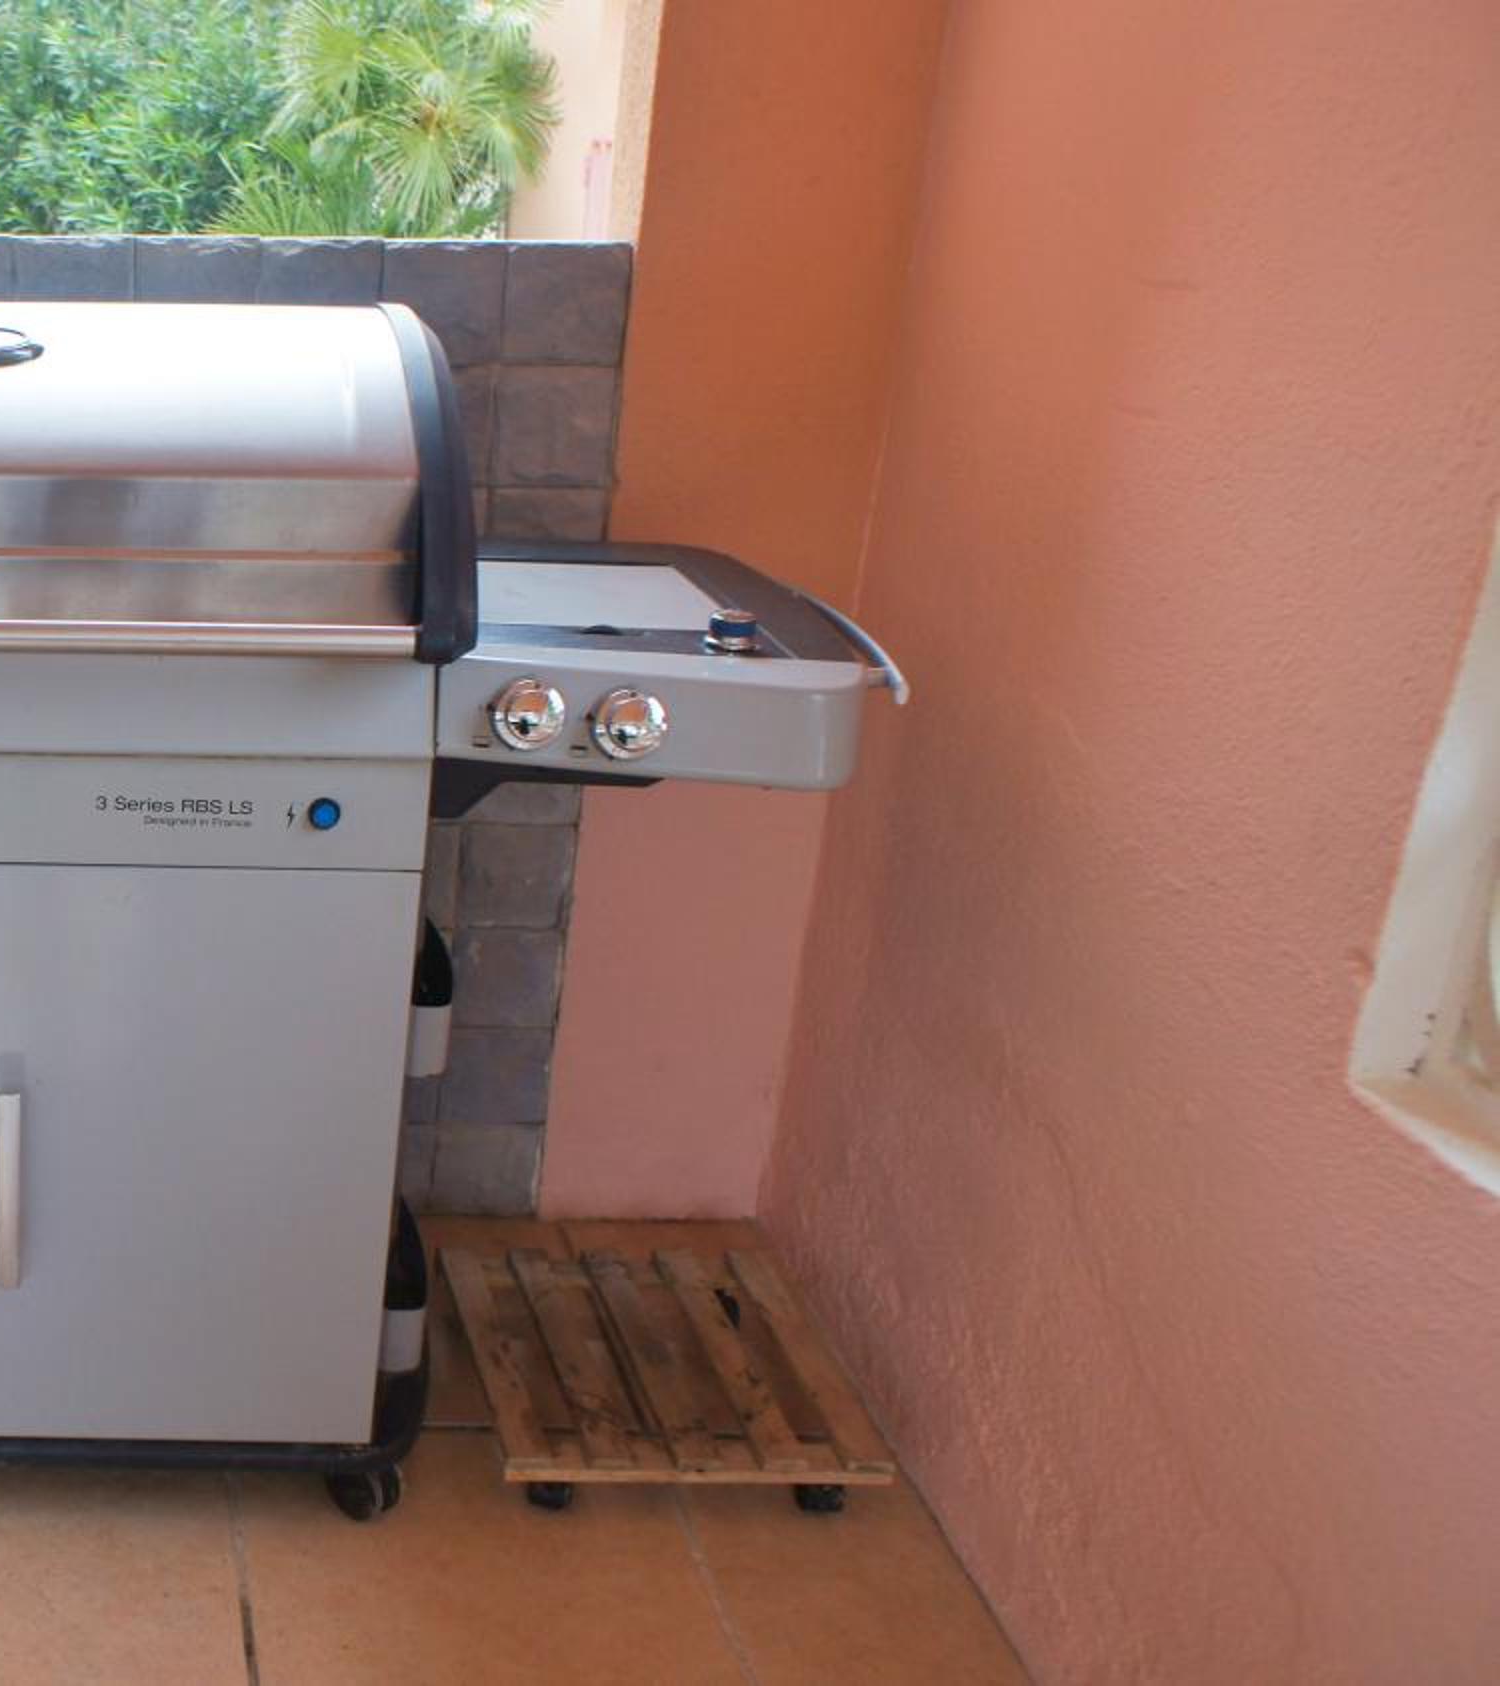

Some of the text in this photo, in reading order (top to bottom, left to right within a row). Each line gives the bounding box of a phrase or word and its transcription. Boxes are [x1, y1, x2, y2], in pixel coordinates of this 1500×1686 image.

[95, 795, 253, 815] 3 Series RBS LS
